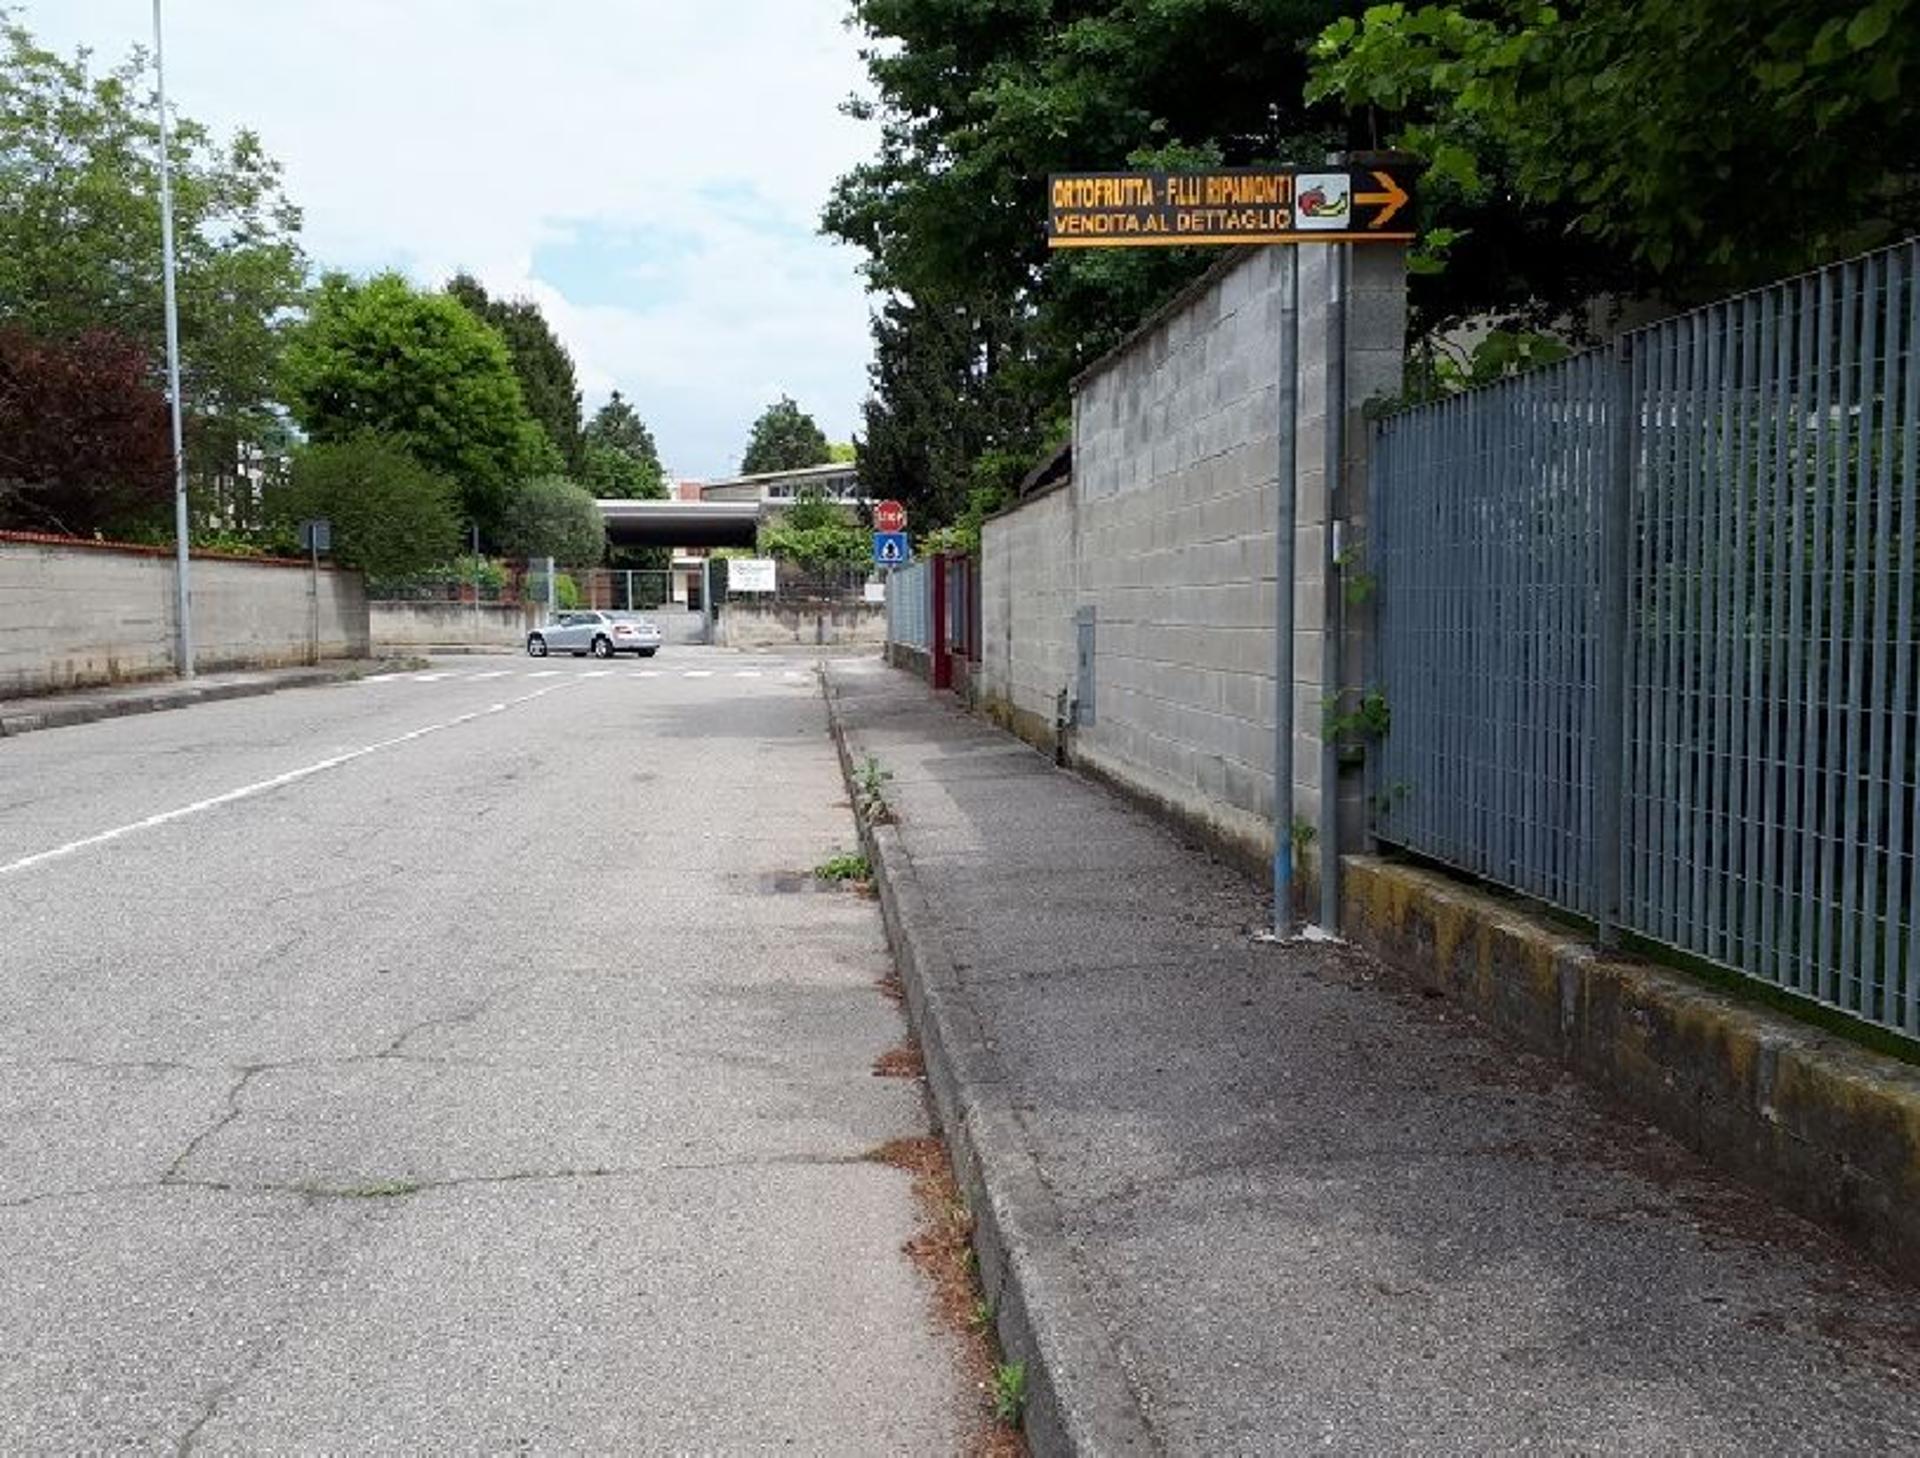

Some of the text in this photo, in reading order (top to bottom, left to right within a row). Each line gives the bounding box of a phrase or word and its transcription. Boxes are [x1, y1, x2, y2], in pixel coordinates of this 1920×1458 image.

[1052, 178, 1154, 208] ORTOFRUTTA
[1054, 208, 1292, 233] VENDITA AL DETTAGLIO
